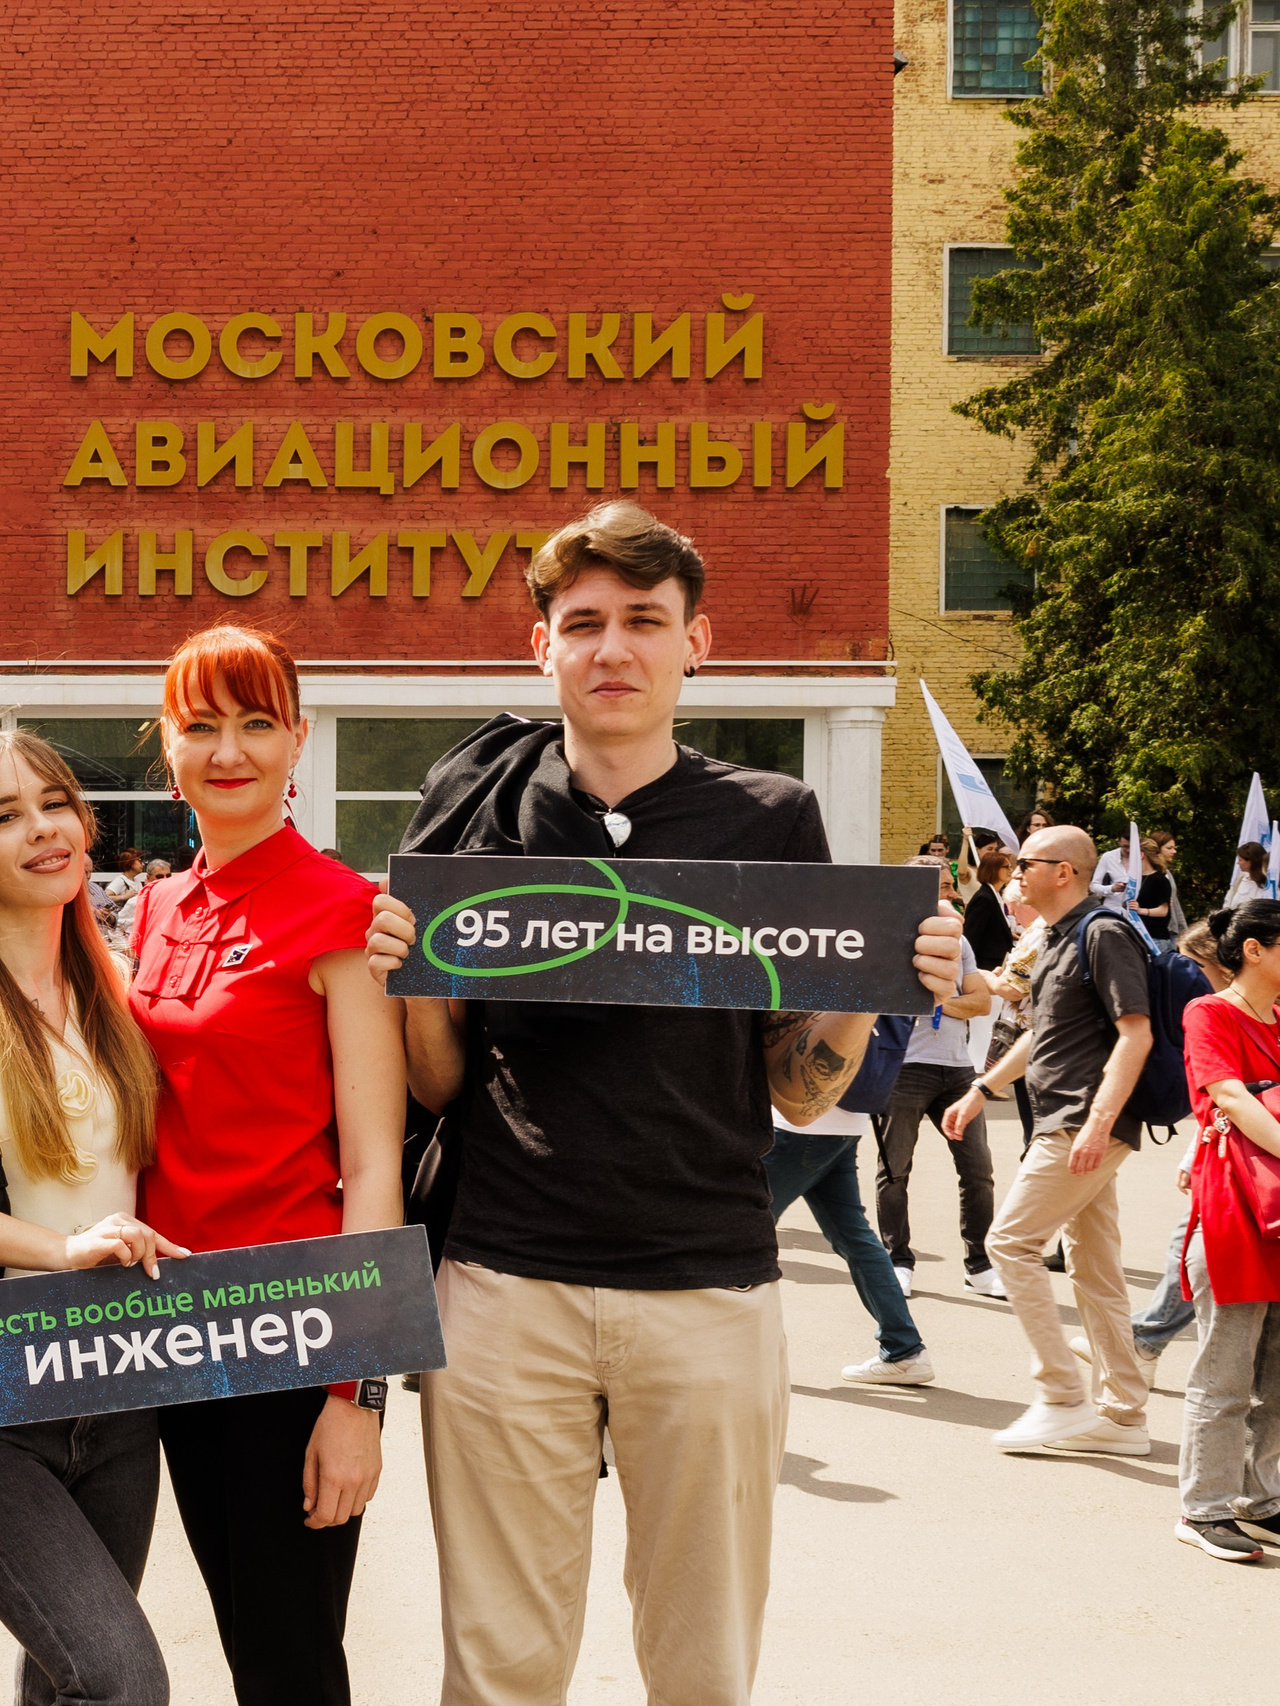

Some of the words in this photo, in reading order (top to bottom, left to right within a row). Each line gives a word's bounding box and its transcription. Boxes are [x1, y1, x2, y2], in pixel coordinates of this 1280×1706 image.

[70, 293, 764, 379] МОСКОВСКИЙ
[63, 402, 845, 495] АВИАЦИОННЫЙ
[455, 909, 510, 948] 95
[521, 920, 605, 949] лет
[616, 923, 673, 952] на
[687, 925, 865, 959] высоте
[65, 1290, 195, 1327] вообще
[202, 1260, 382, 1309] маленький
[24, 1307, 333, 1386] инженер
